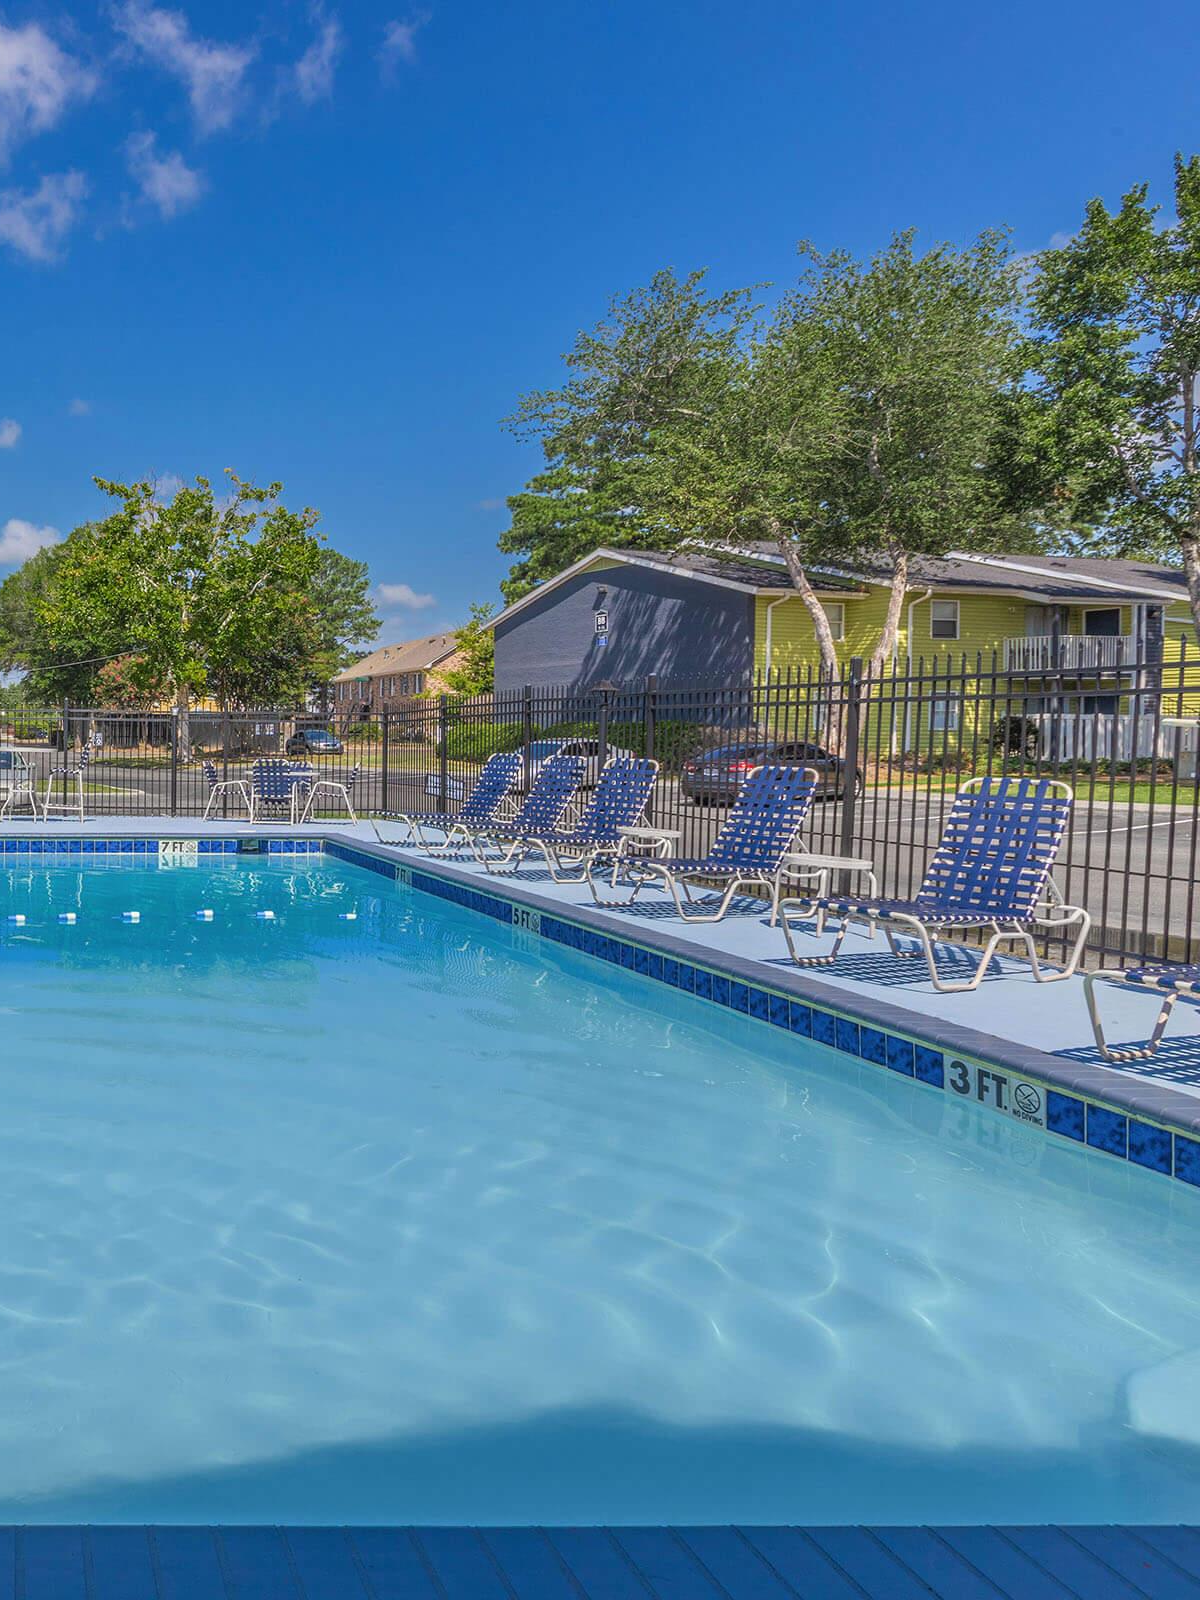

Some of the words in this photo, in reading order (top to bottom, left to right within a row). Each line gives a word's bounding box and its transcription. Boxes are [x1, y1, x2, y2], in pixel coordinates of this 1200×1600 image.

[161, 841, 169, 852] 7
[514, 907, 520, 926] 5
[950, 1060, 970, 1095] 3
[977, 1068, 1008, 1110] FT.
[1012, 1108, 1022, 1118] NO
[1021, 1111, 1044, 1126] DIVING
